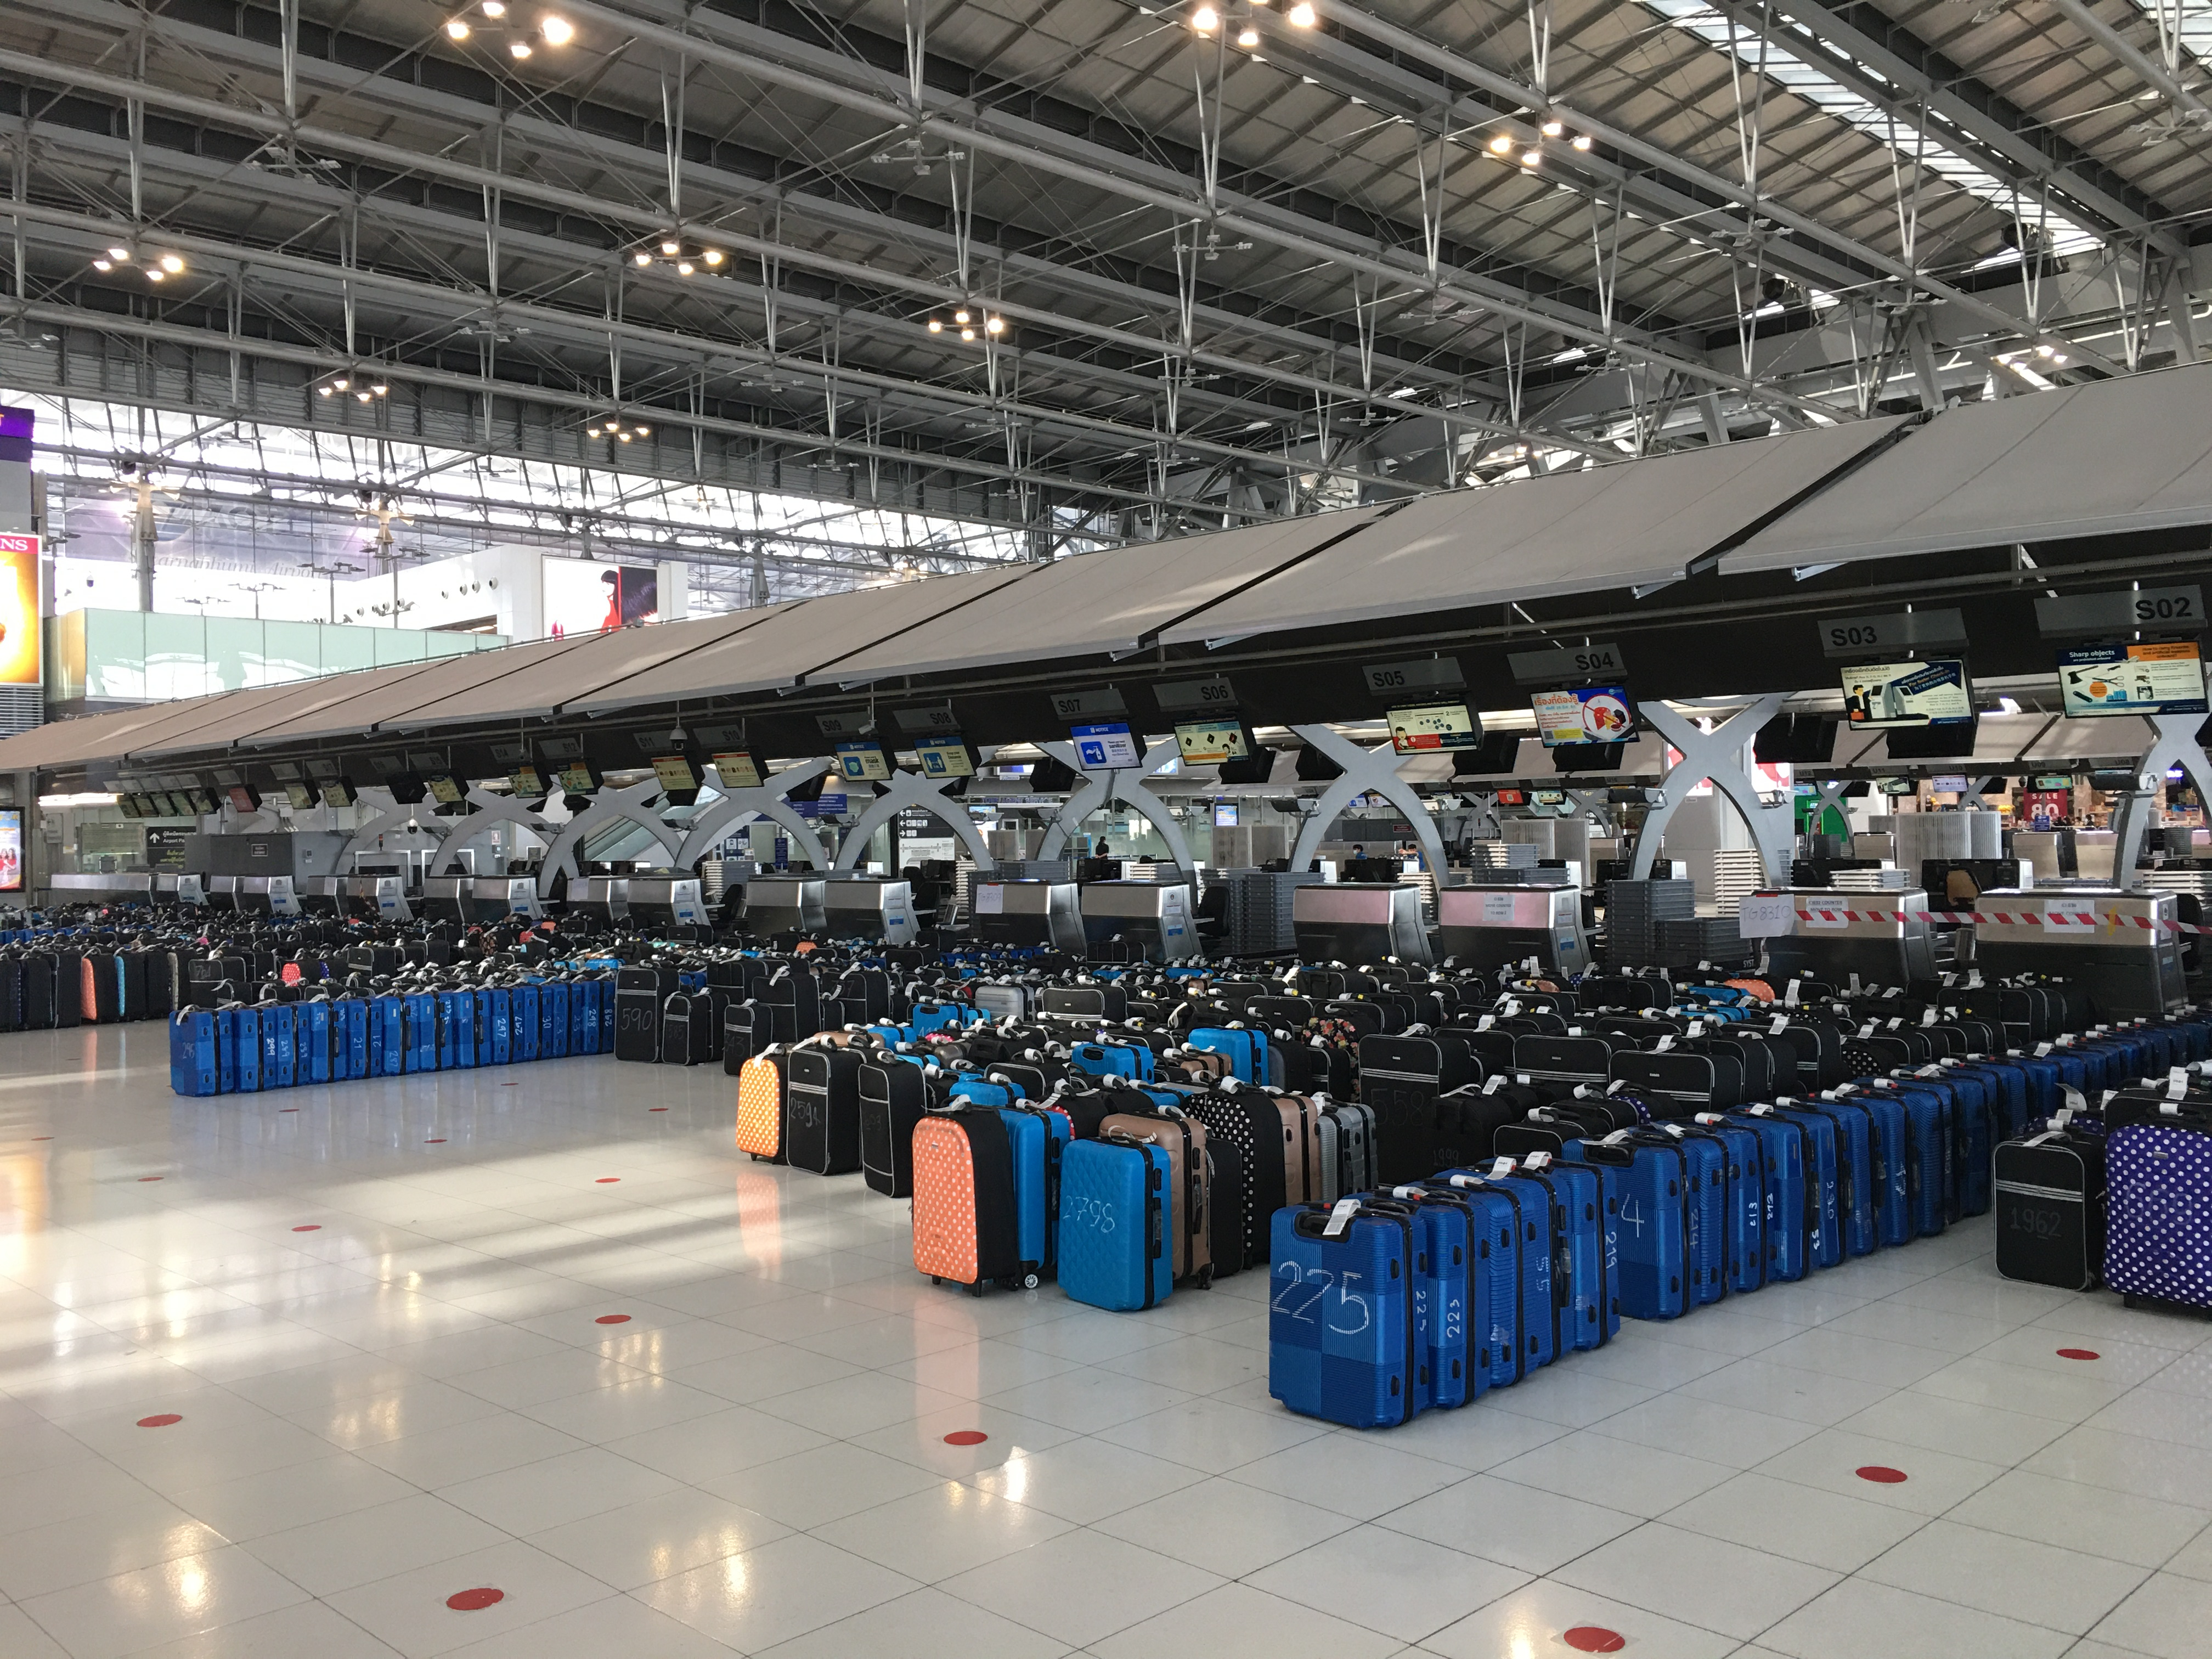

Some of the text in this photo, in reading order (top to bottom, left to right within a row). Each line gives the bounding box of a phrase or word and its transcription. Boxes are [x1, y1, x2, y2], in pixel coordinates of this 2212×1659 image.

[156, 555, 253, 573] arnabhumi
[2135, 597, 2192, 620] S02
[1831, 626, 1877, 646] S03
[1575, 652, 1613, 670] S04
[1373, 670, 1405, 687] S05
[1201, 685, 1228, 700] S06
[1058, 699, 1080, 713] S07
[822, 720, 842, 731] S09
[930, 712, 951, 724] S08
[639, 737, 654, 747] S11
[722, 730, 740, 741] S10
[562, 742, 578, 752] S12
[2032, 803, 2059, 821] 80
[1741, 905, 1791, 922] TG8310
[497, 1018, 506, 1037] 297
[515, 1015, 523, 1035] 297
[588, 1009, 597, 1028] 298
[620, 1008, 653, 1031] 590
[267, 1038, 275, 1056] 299
[1371, 1087, 1424, 1126] 558
[1063, 1195, 1115, 1233] 2798
[1690, 1208, 1699, 1250] 214
[2010, 1208, 2062, 1240] 1962
[1606, 1232, 1617, 1269] 219
[1271, 1261, 1369, 1334] 225
[1416, 1290, 1427, 1331] 225
[1447, 1299, 1460, 1338] 223
